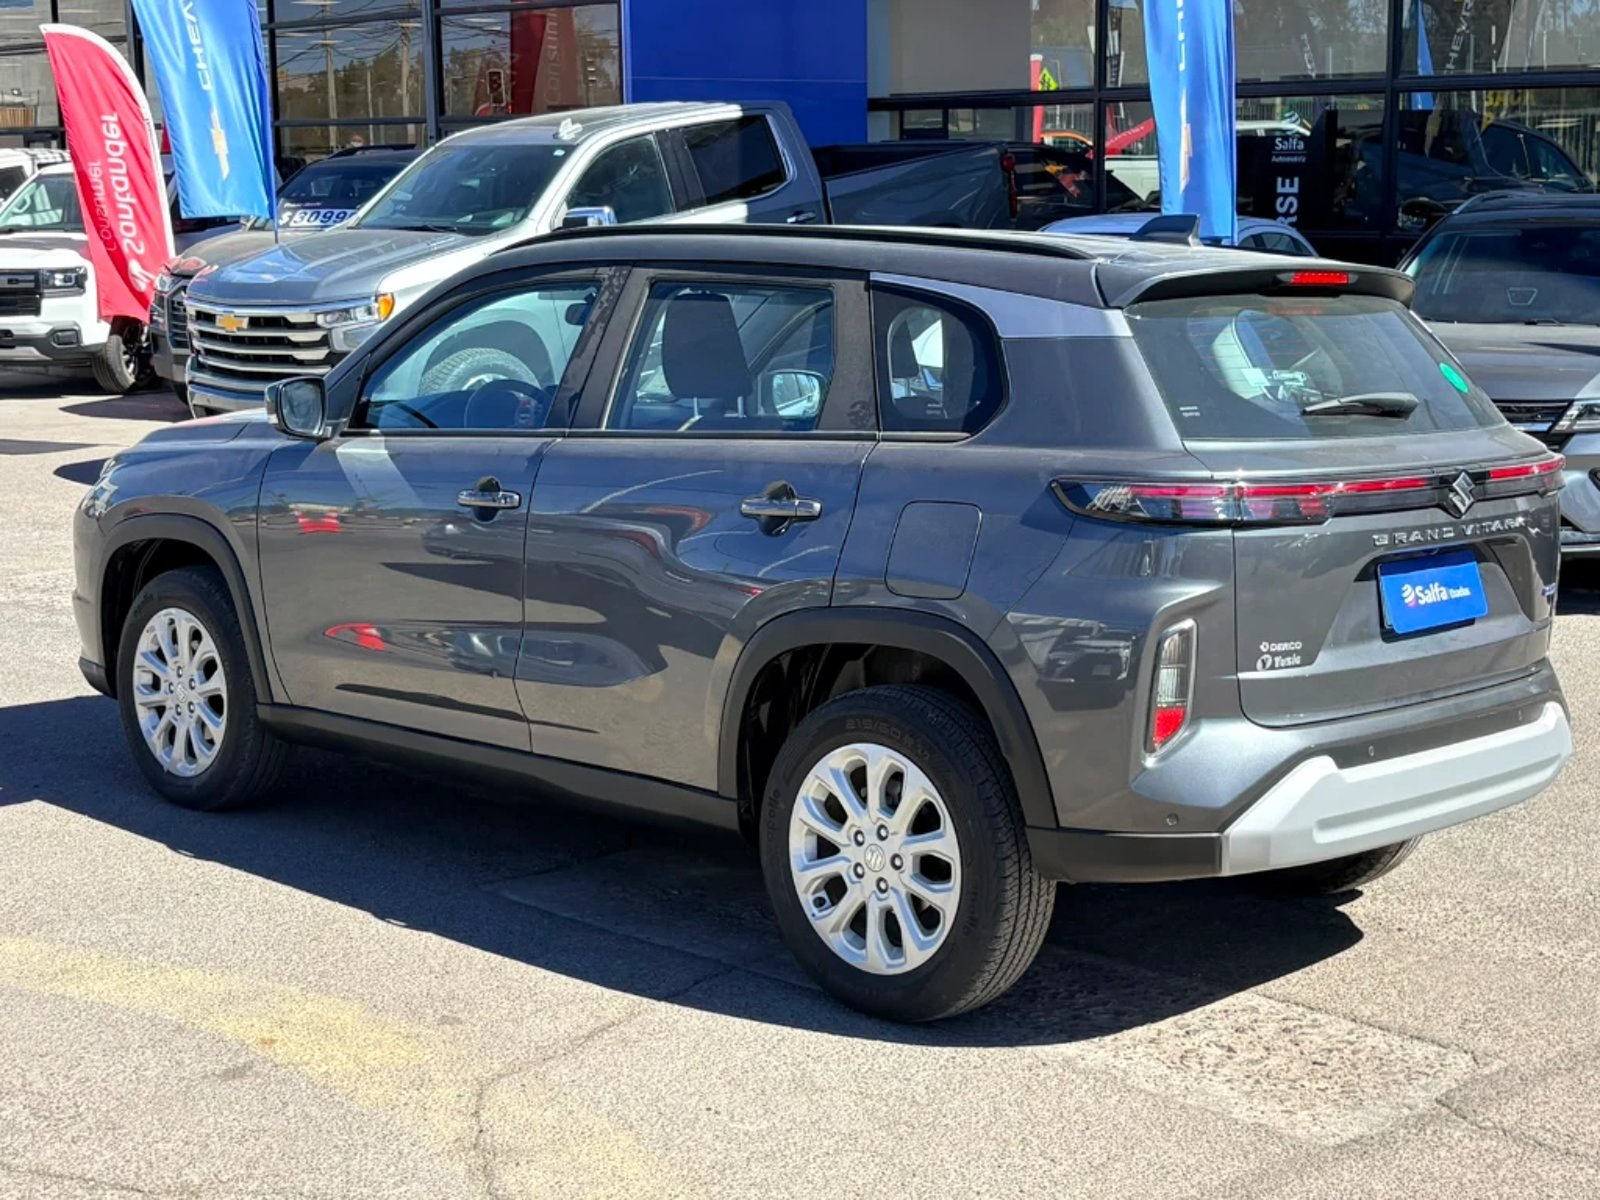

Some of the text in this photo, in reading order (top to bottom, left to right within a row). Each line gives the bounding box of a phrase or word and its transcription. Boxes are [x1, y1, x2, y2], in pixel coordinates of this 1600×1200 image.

[1274, 137, 1305, 151] Salfa
[1372, 515, 1526, 547] GRAND VITARA
[1415, 581, 1448, 605] Salfa
[1270, 641, 1303, 652] DERCO
